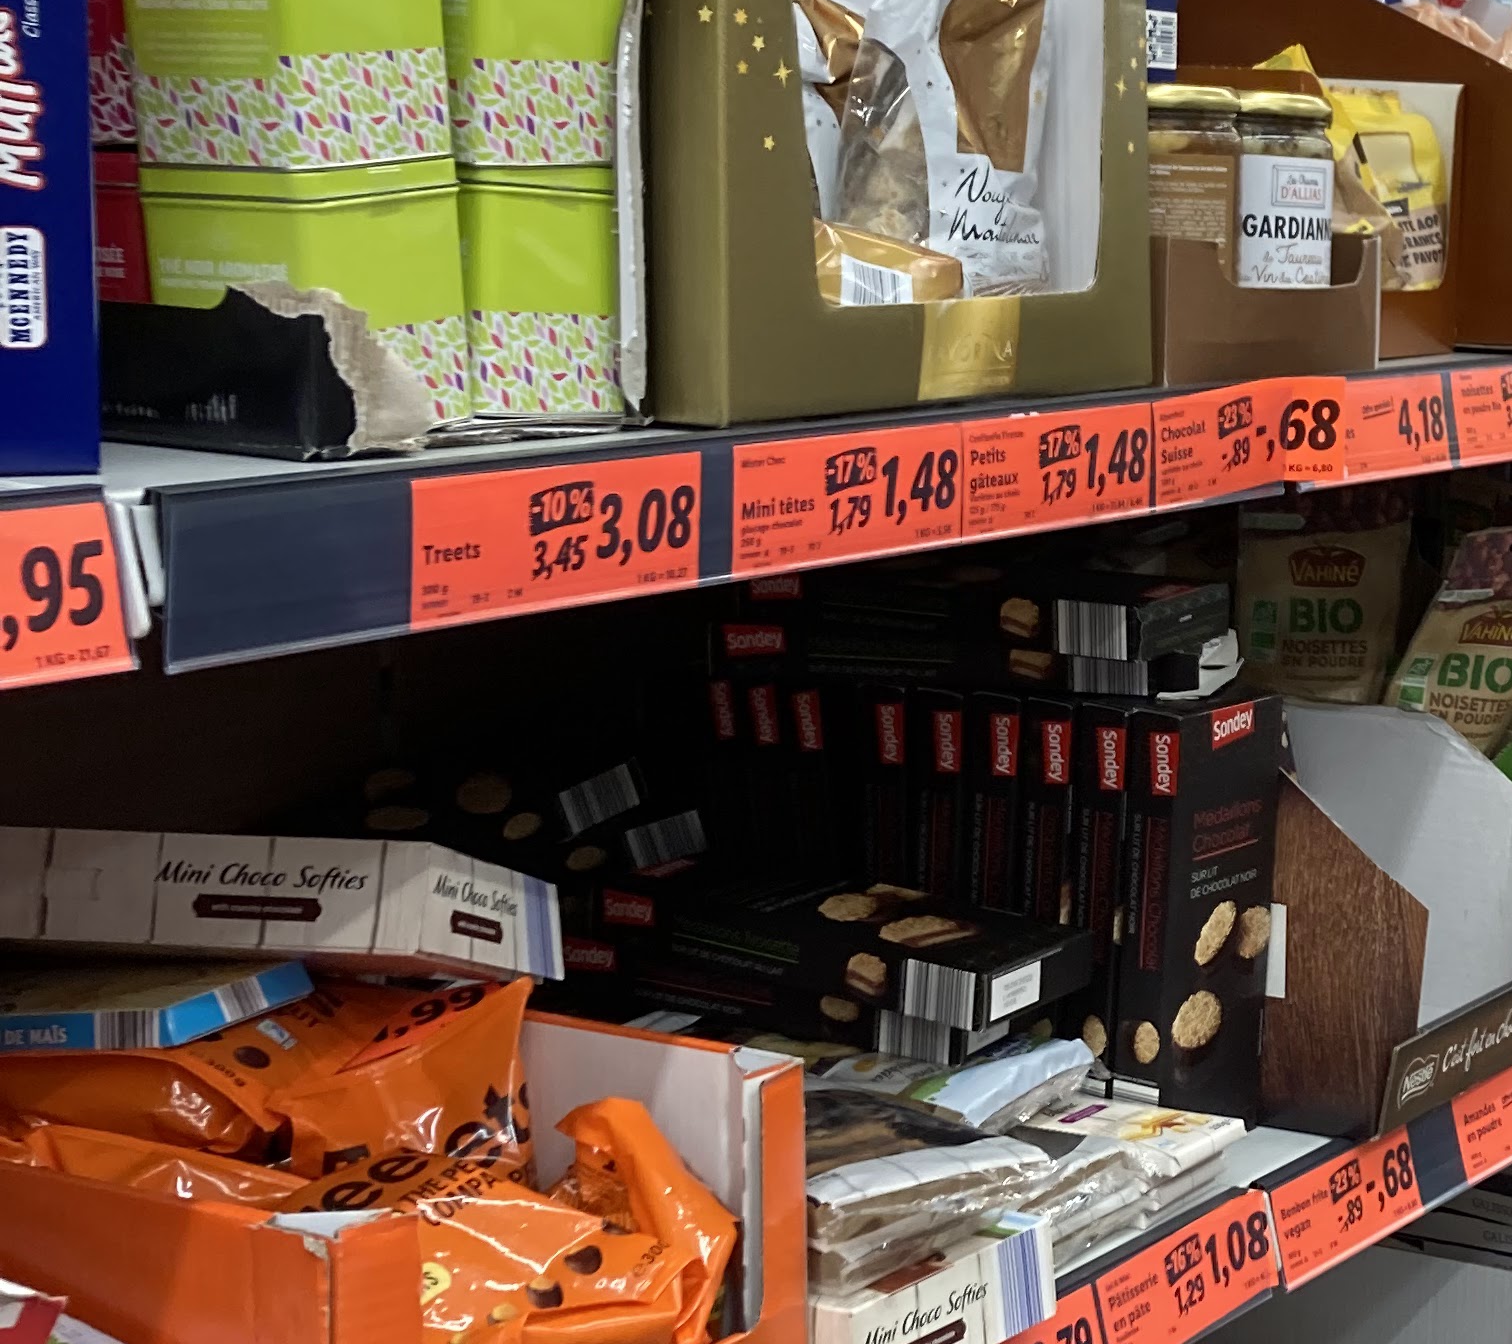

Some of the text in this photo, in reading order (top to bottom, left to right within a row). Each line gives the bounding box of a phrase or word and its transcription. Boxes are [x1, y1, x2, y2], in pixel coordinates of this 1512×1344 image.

[6, 231, 30, 344] MCENNEDY
[1160, 420, 1206, 443] Chocolat
[1256, 398, 1341, 462] -,68
[1398, 395, 1445, 452] 4,18
[970, 447, 1007, 467] Petits
[1084, 426, 1149, 497] 1,48
[1160, 443, 1194, 465] Suisse
[881, 447, 960, 527] 1,48
[969, 469, 1019, 496] gâteaux
[596, 484, 697, 567] 3,08
[741, 495, 815, 522] Mini têtes
[423, 540, 481, 568] Treets
[530, 534, 588, 582] 3,45
[726, 628, 783, 652] Sondey
[1288, 596, 1364, 636] BIO
[1281, 638, 1368, 655] NOISETTES
[881, 703, 897, 763] Sondey
[938, 712, 954, 773] Sondey
[996, 716, 1013, 775] Sondey
[1212, 707, 1254, 740] Sondey
[1048, 722, 1064, 783] Sondey
[1101, 729, 1118, 791] Sondey
[1151, 731, 1171, 793] Sondey
[155, 860, 369, 892] Mini Choco Softies
[4, 1020, 68, 1045] DE MAÏS
[1463, 1100, 1496, 1128] Amandes
[1366, 1142, 1413, 1213] -,68
[1205, 1210, 1269, 1295] 1,08
[1282, 1216, 1312, 1243] vegan
[901, 1301, 942, 1338] Choco
[946, 1278, 988, 1316] Softies
[1107, 1272, 1159, 1312] Pâtisserie
